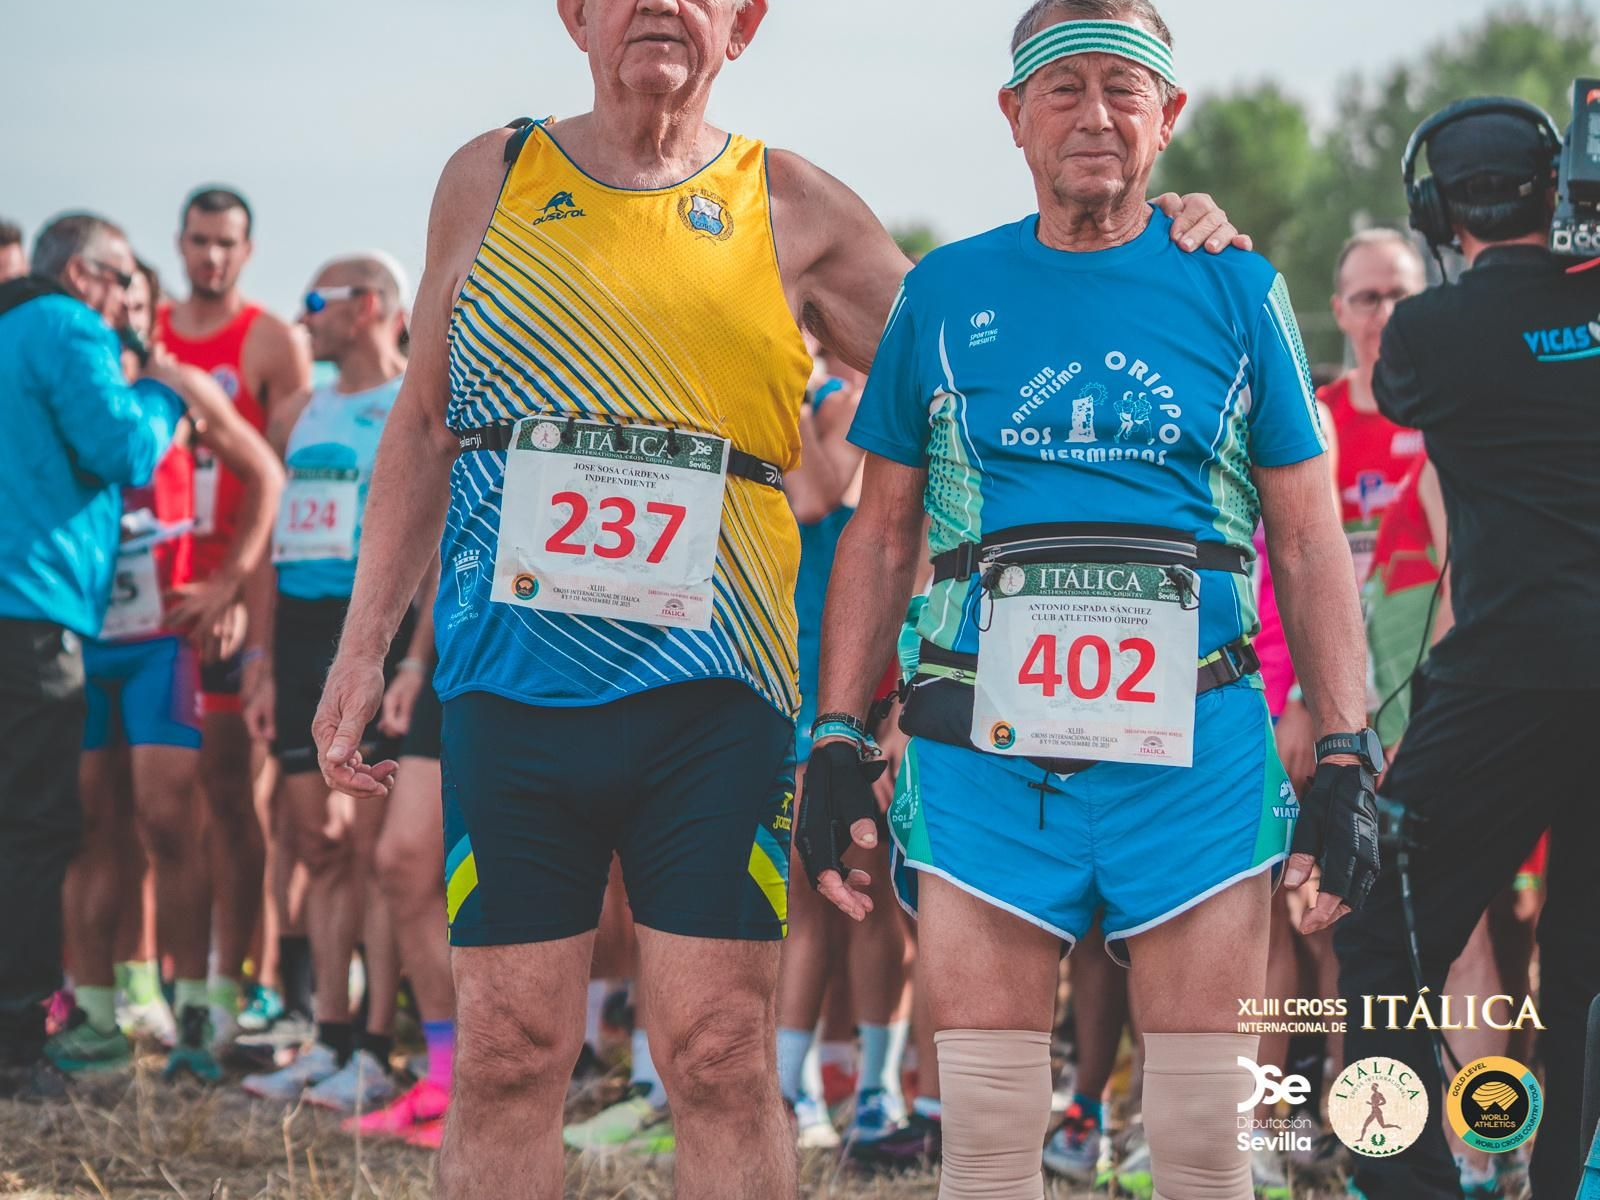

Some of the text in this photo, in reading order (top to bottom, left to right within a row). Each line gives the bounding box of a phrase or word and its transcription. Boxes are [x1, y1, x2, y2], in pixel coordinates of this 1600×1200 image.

[1011, 361, 1082, 425] ATLETISMO
[1019, 366, 1056, 398] CLUB
[1104, 350, 1182, 445] ORIPPO
[1000, 426, 1052, 446] DOS
[573, 462, 596, 472] JOSE
[597, 465, 620, 475] SOSA
[585, 474, 657, 489] INDEPENDIENTE
[545, 491, 687, 564] 237
[1040, 564, 1143, 592] ITÁLICA
[1028, 603, 1070, 611] ANTONIO
[1072, 604, 1107, 613] ESPADA
[1031, 613, 1056, 621] CLUB
[1058, 614, 1112, 623] ATLETISMO
[1018, 634, 1156, 703] 402
